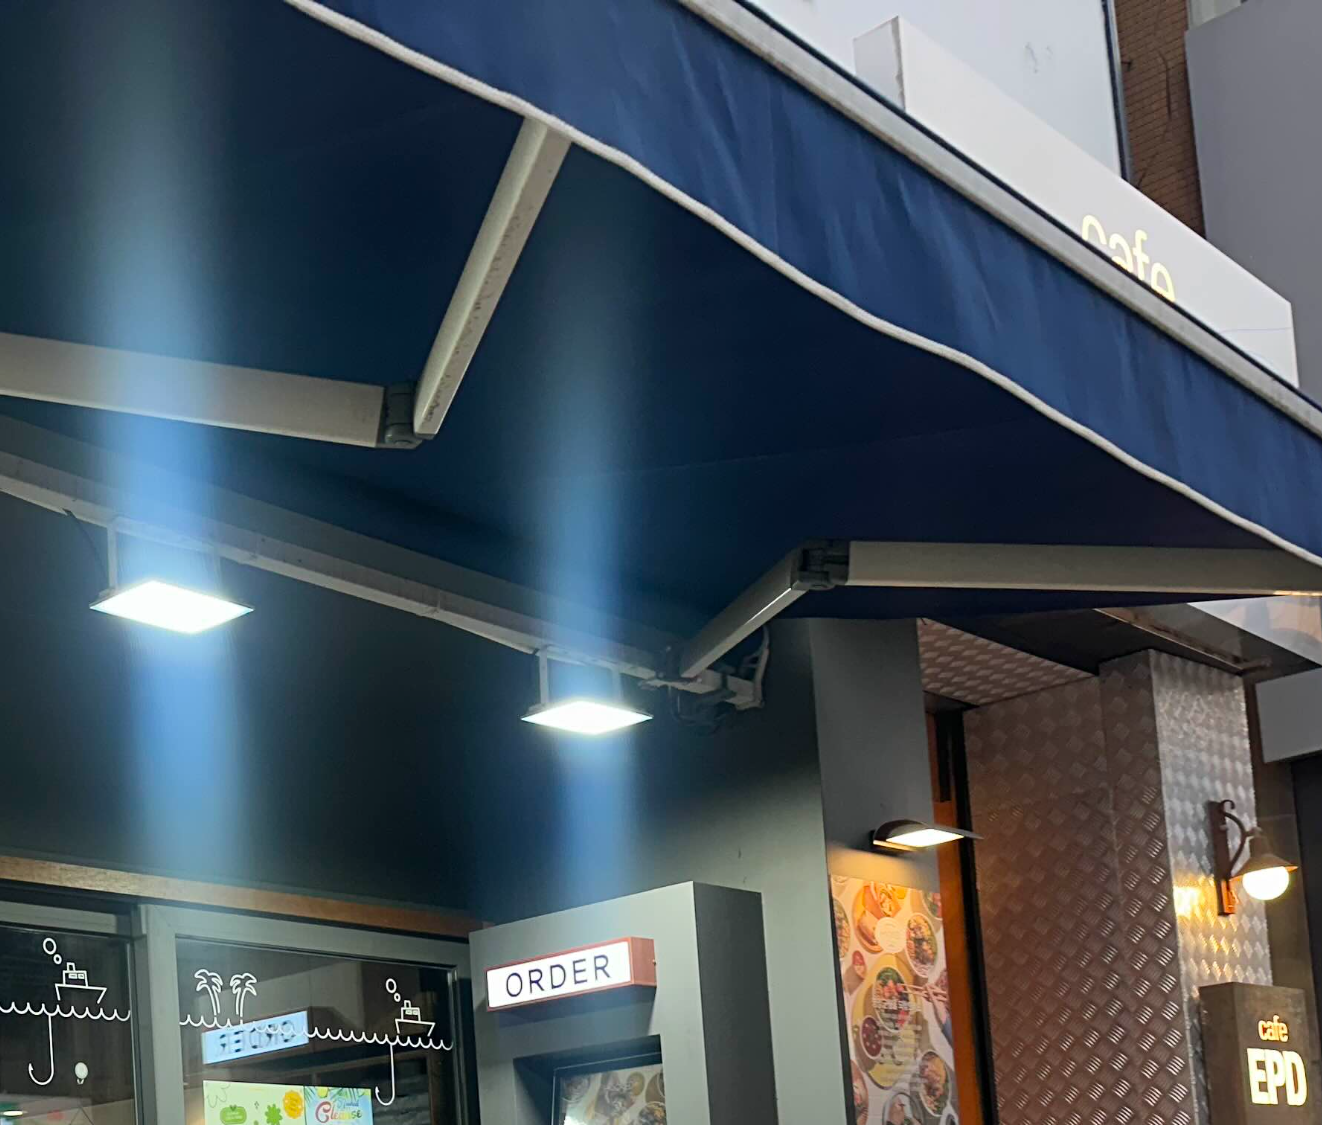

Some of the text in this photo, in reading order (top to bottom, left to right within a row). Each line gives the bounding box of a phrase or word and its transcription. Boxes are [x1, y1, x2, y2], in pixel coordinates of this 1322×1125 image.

[506, 954, 612, 997] ORDER
[1258, 1014, 1289, 1043] cafe
[1247, 1048, 1307, 1106] EPD
